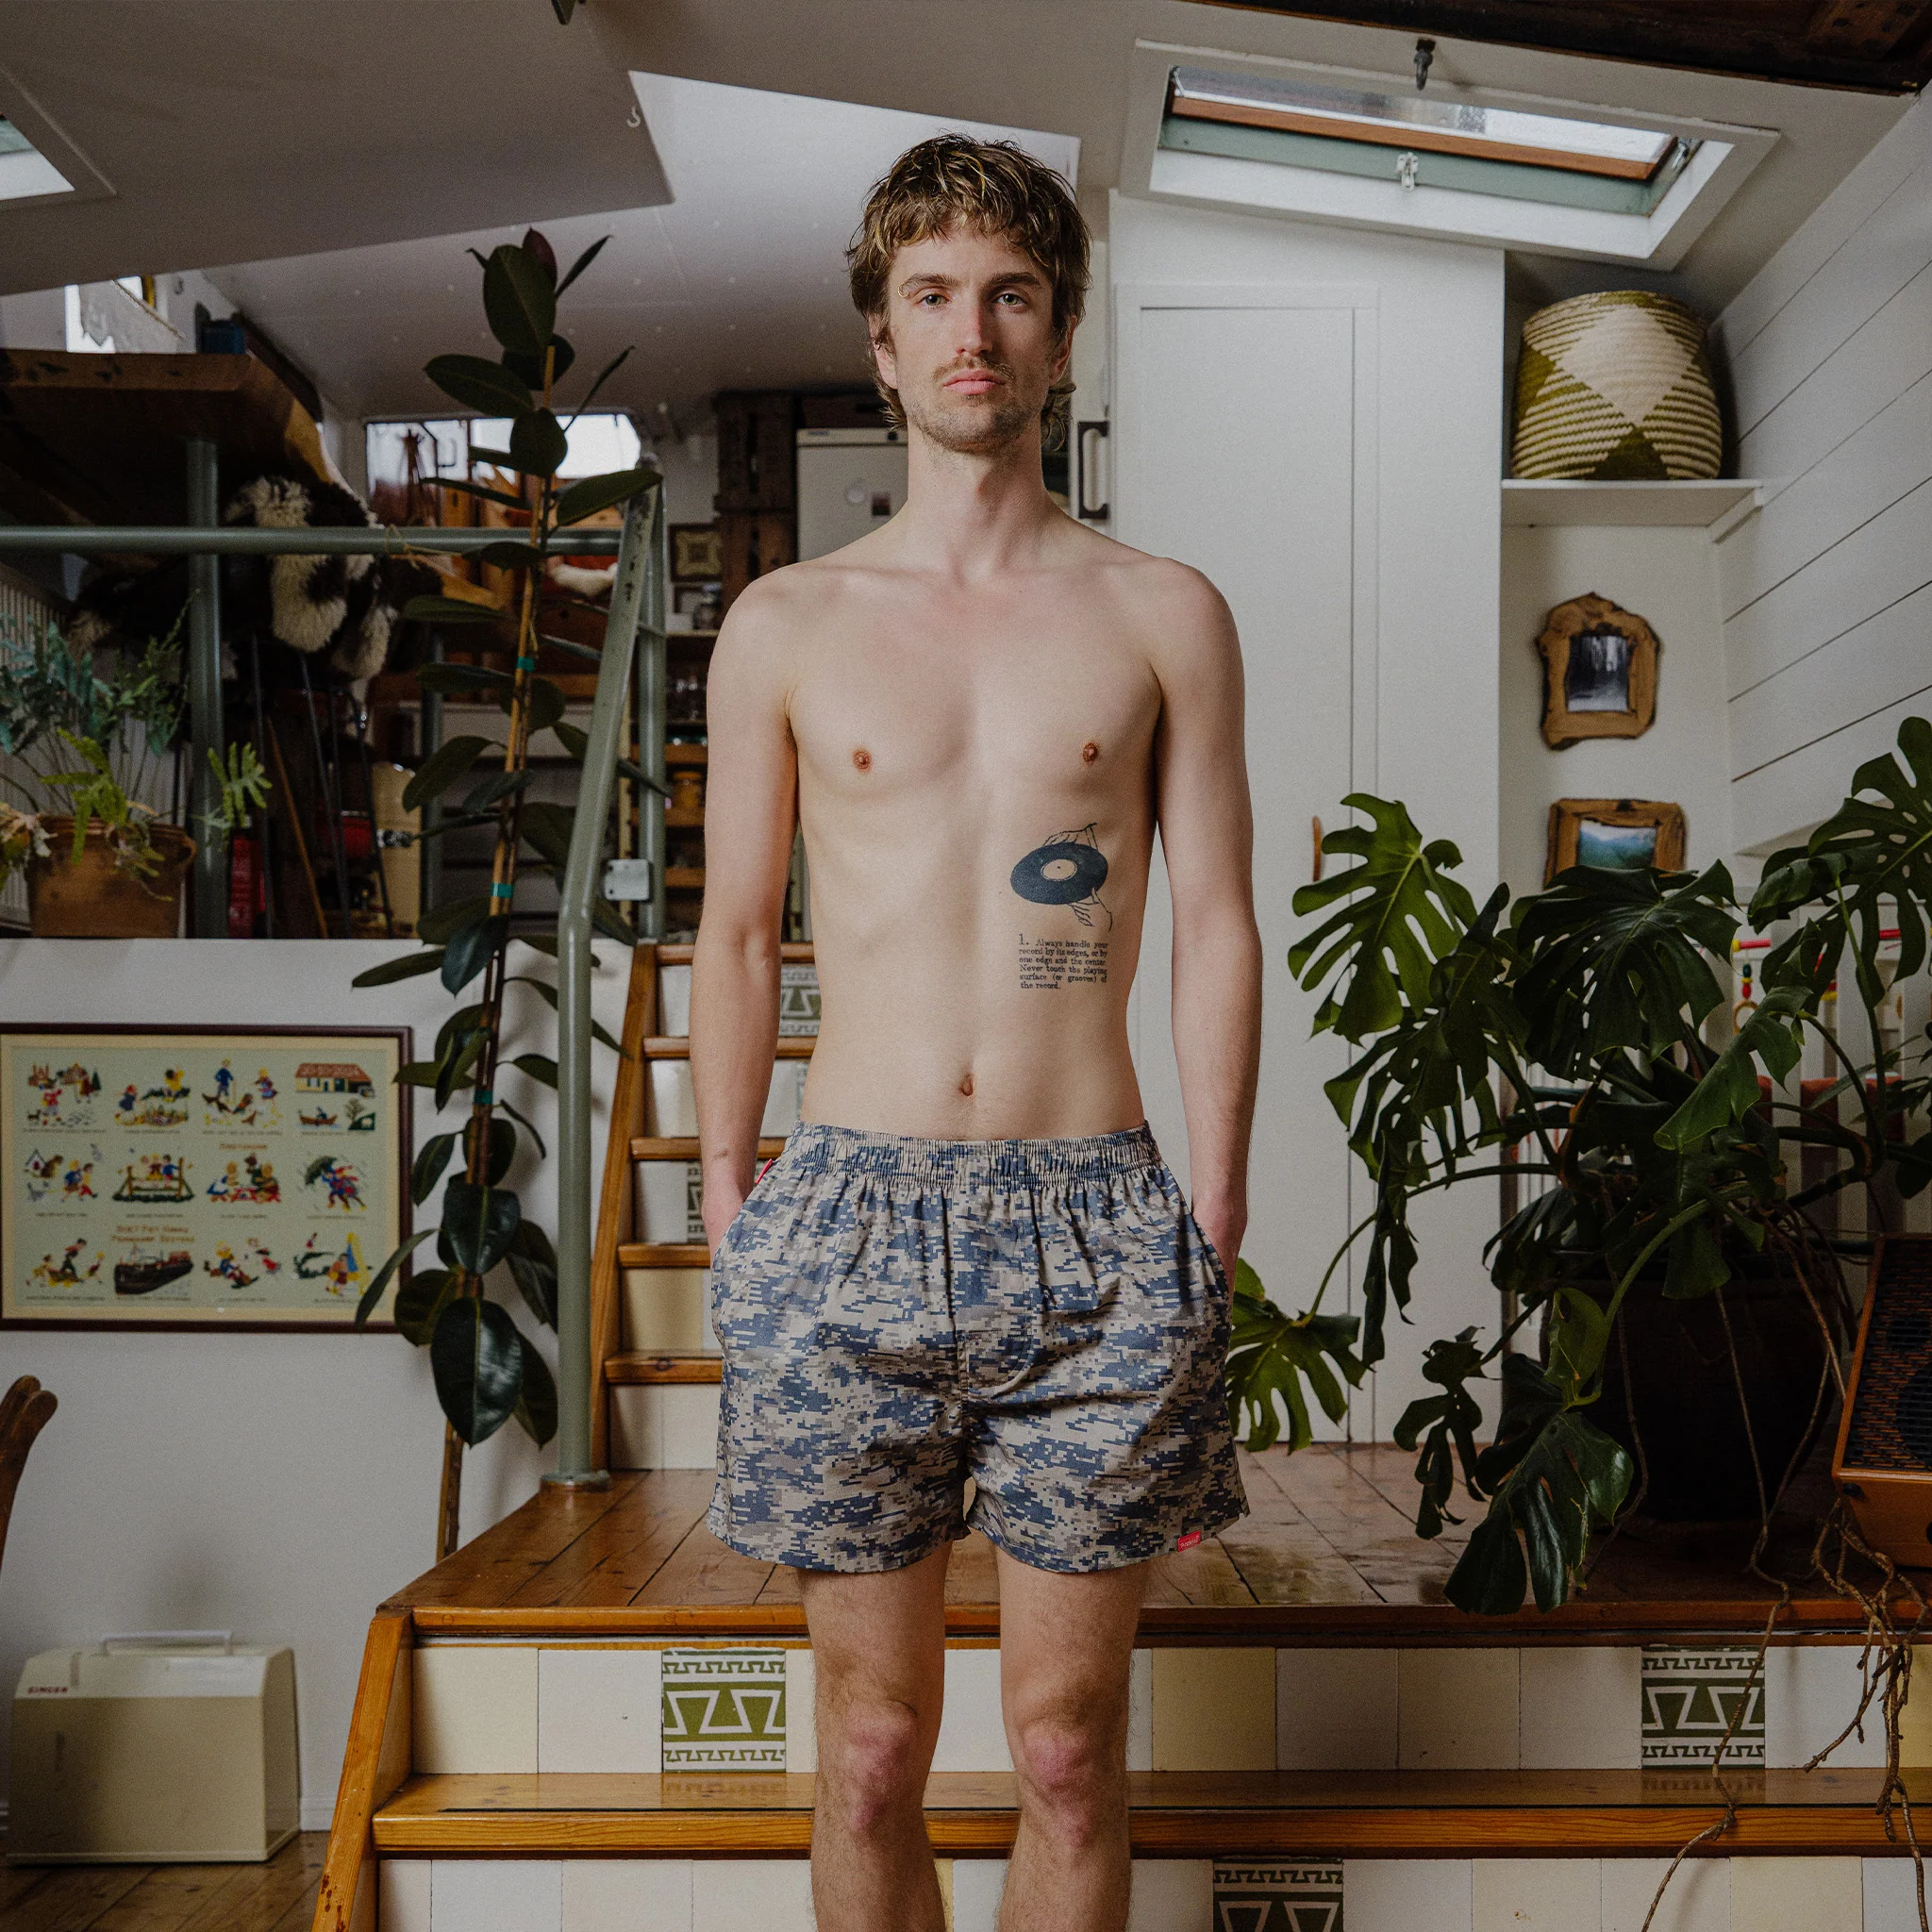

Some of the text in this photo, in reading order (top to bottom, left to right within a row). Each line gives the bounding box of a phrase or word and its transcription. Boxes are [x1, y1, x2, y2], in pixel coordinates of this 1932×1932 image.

[1019, 933, 1029, 945] 1.
[1036, 939, 1062, 948] Always
[1045, 947, 1055, 957] by
[1067, 948, 1089, 958] edges,
[1100, 949, 1108, 958] by
[1036, 956, 1052, 965] edge
[1084, 966, 1108, 974] playing
